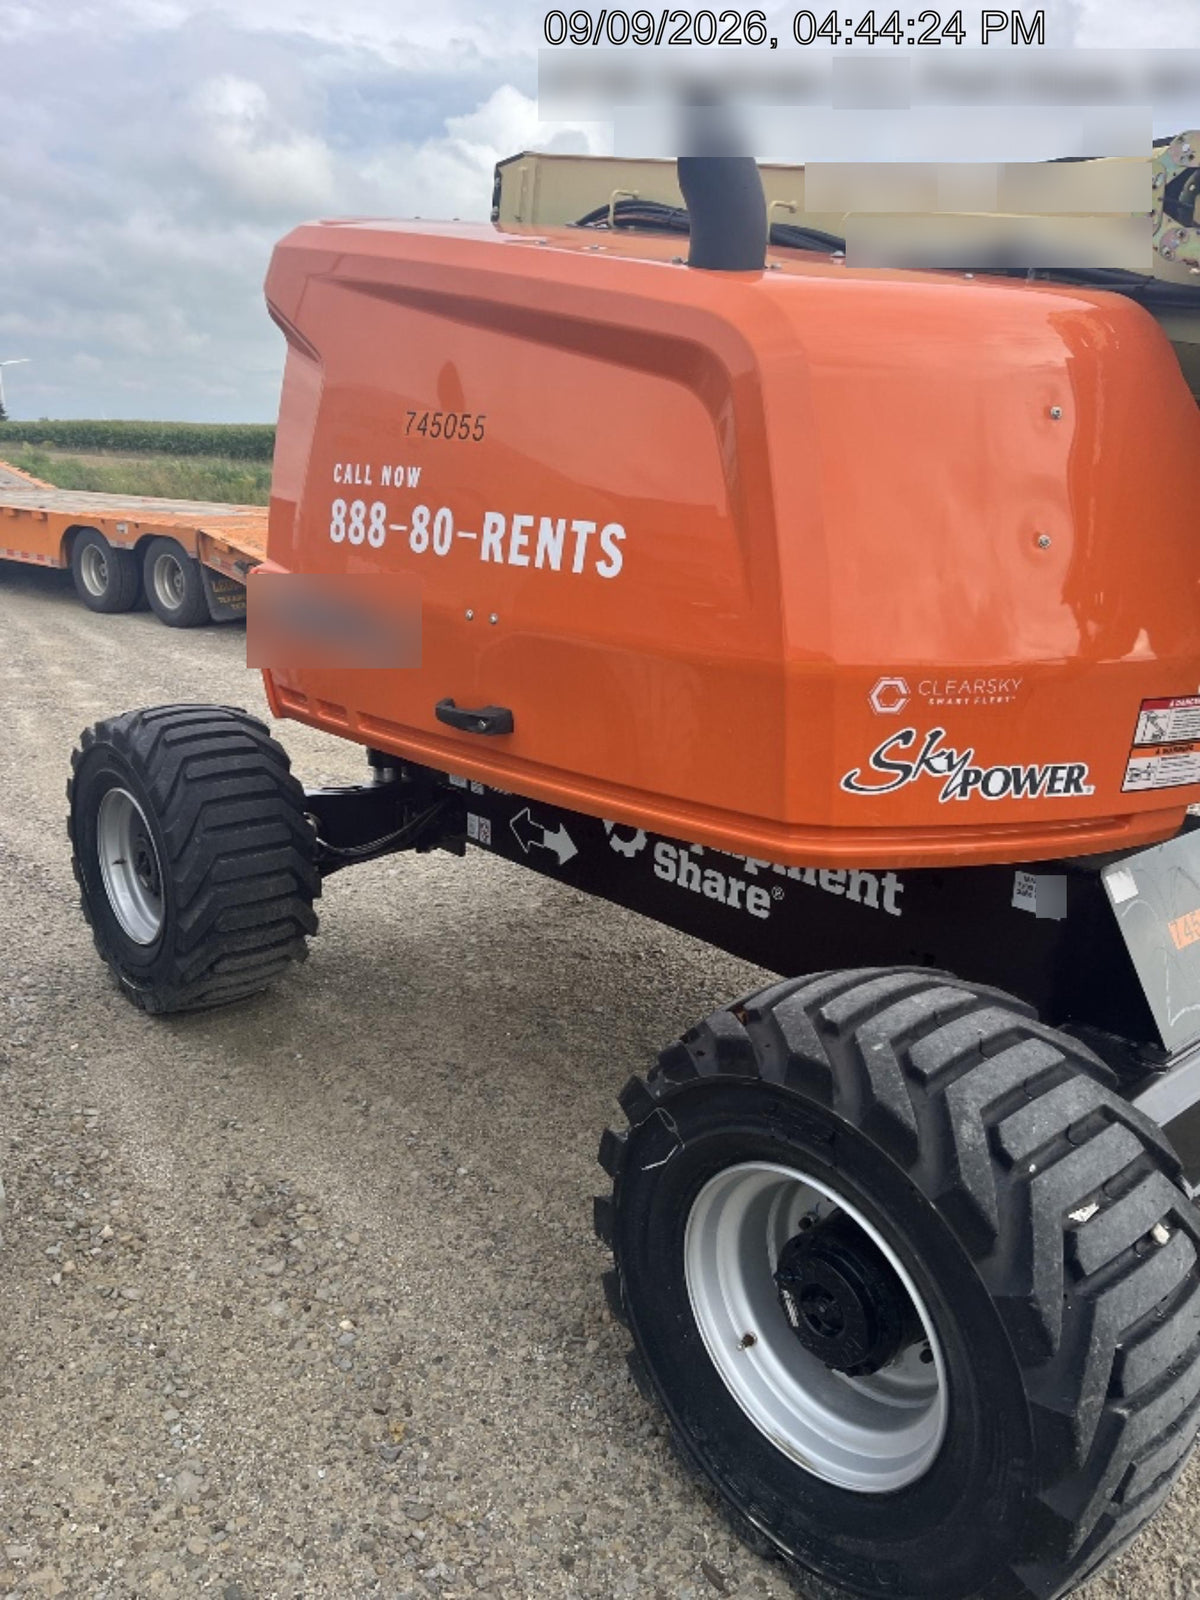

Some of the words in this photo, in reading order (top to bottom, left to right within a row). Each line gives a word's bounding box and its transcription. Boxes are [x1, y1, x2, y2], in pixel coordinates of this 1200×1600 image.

[405, 411, 486, 441] 745055
[333, 463, 372, 485] CALL
[381, 465, 421, 488] NOW
[330, 498, 626, 579] 888-80-RENTS
[918, 677, 1023, 696] CLEARSKY
